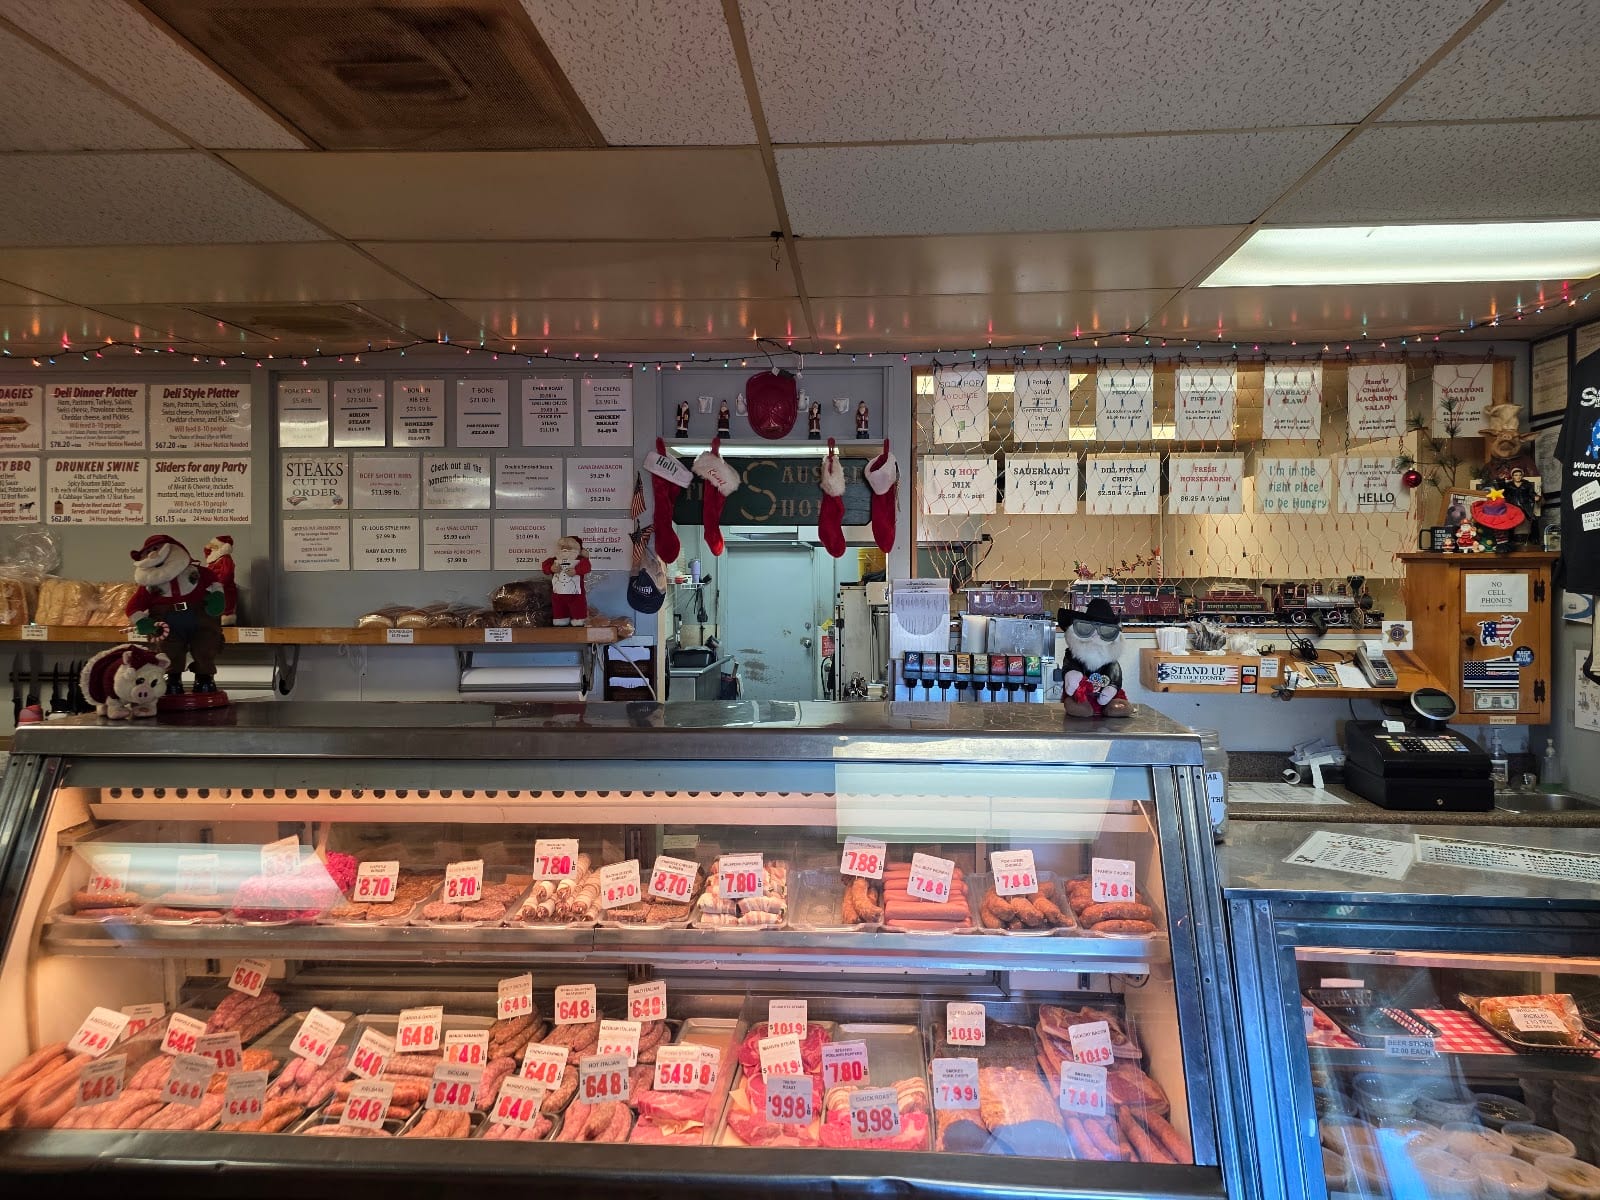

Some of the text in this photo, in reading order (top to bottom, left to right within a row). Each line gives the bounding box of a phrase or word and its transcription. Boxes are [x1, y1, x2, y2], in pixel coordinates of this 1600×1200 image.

[54, 387, 138, 399] Deli Dinner Platter
[163, 388, 240, 400] Deli Style Platter
[10, 461, 32, 472] BBQ
[56, 462, 140, 472] DRUNKEN SWINE
[155, 462, 248, 474] Sliders for any Party
[286, 462, 344, 477] STEAKS
[656, 456, 679, 477] Holly
[1269, 466, 1316, 476] I'm in the
[292, 489, 336, 497] ORDER
[1358, 492, 1395, 503] HELLO
[1264, 498, 1327, 509] to be Hungry
[1171, 666, 1208, 675] STAND
[1409, 1040, 1434, 1048] STICKS
